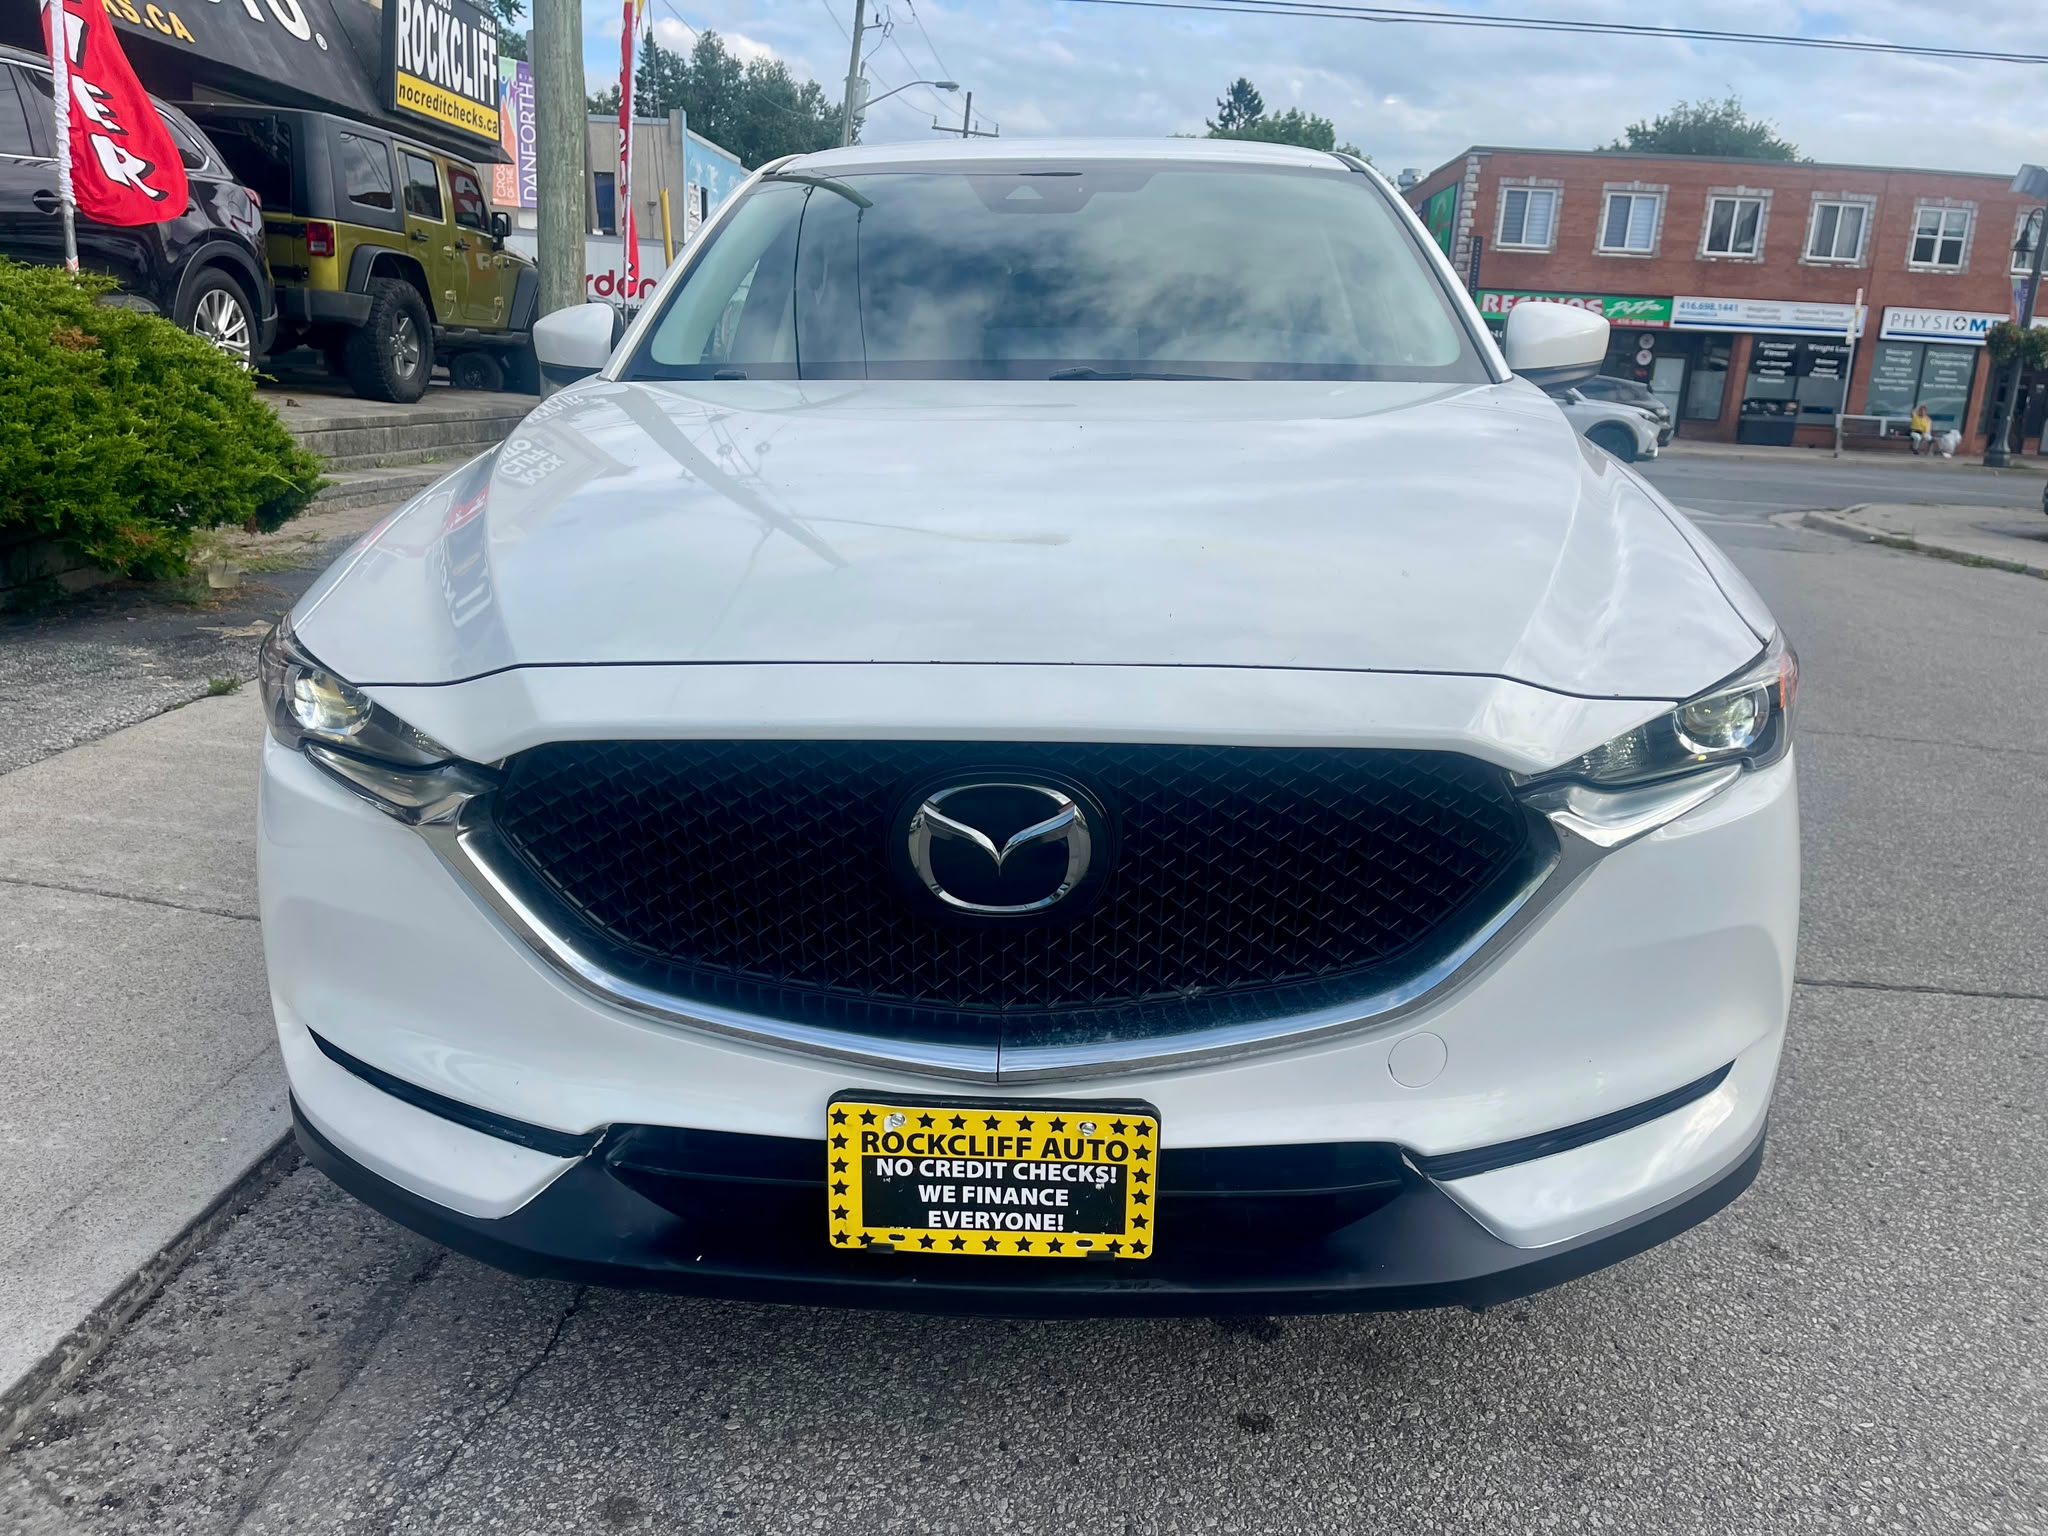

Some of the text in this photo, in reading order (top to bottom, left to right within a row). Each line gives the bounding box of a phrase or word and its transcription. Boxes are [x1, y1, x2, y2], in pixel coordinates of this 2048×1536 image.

[398, 0, 498, 106] ROCKCLIFF
[398, 83, 498, 134] nocreditchecks.ca
[519, 81, 538, 201] DANFORTH
[861, 1131, 1129, 1162] ROCKCLIFF AUTO
[876, 1158, 1117, 1185] NO CREDIT CHECKS!
[918, 1184, 1069, 1207] WE FINANCE
[928, 1210, 1064, 1231] EVERYONE!
